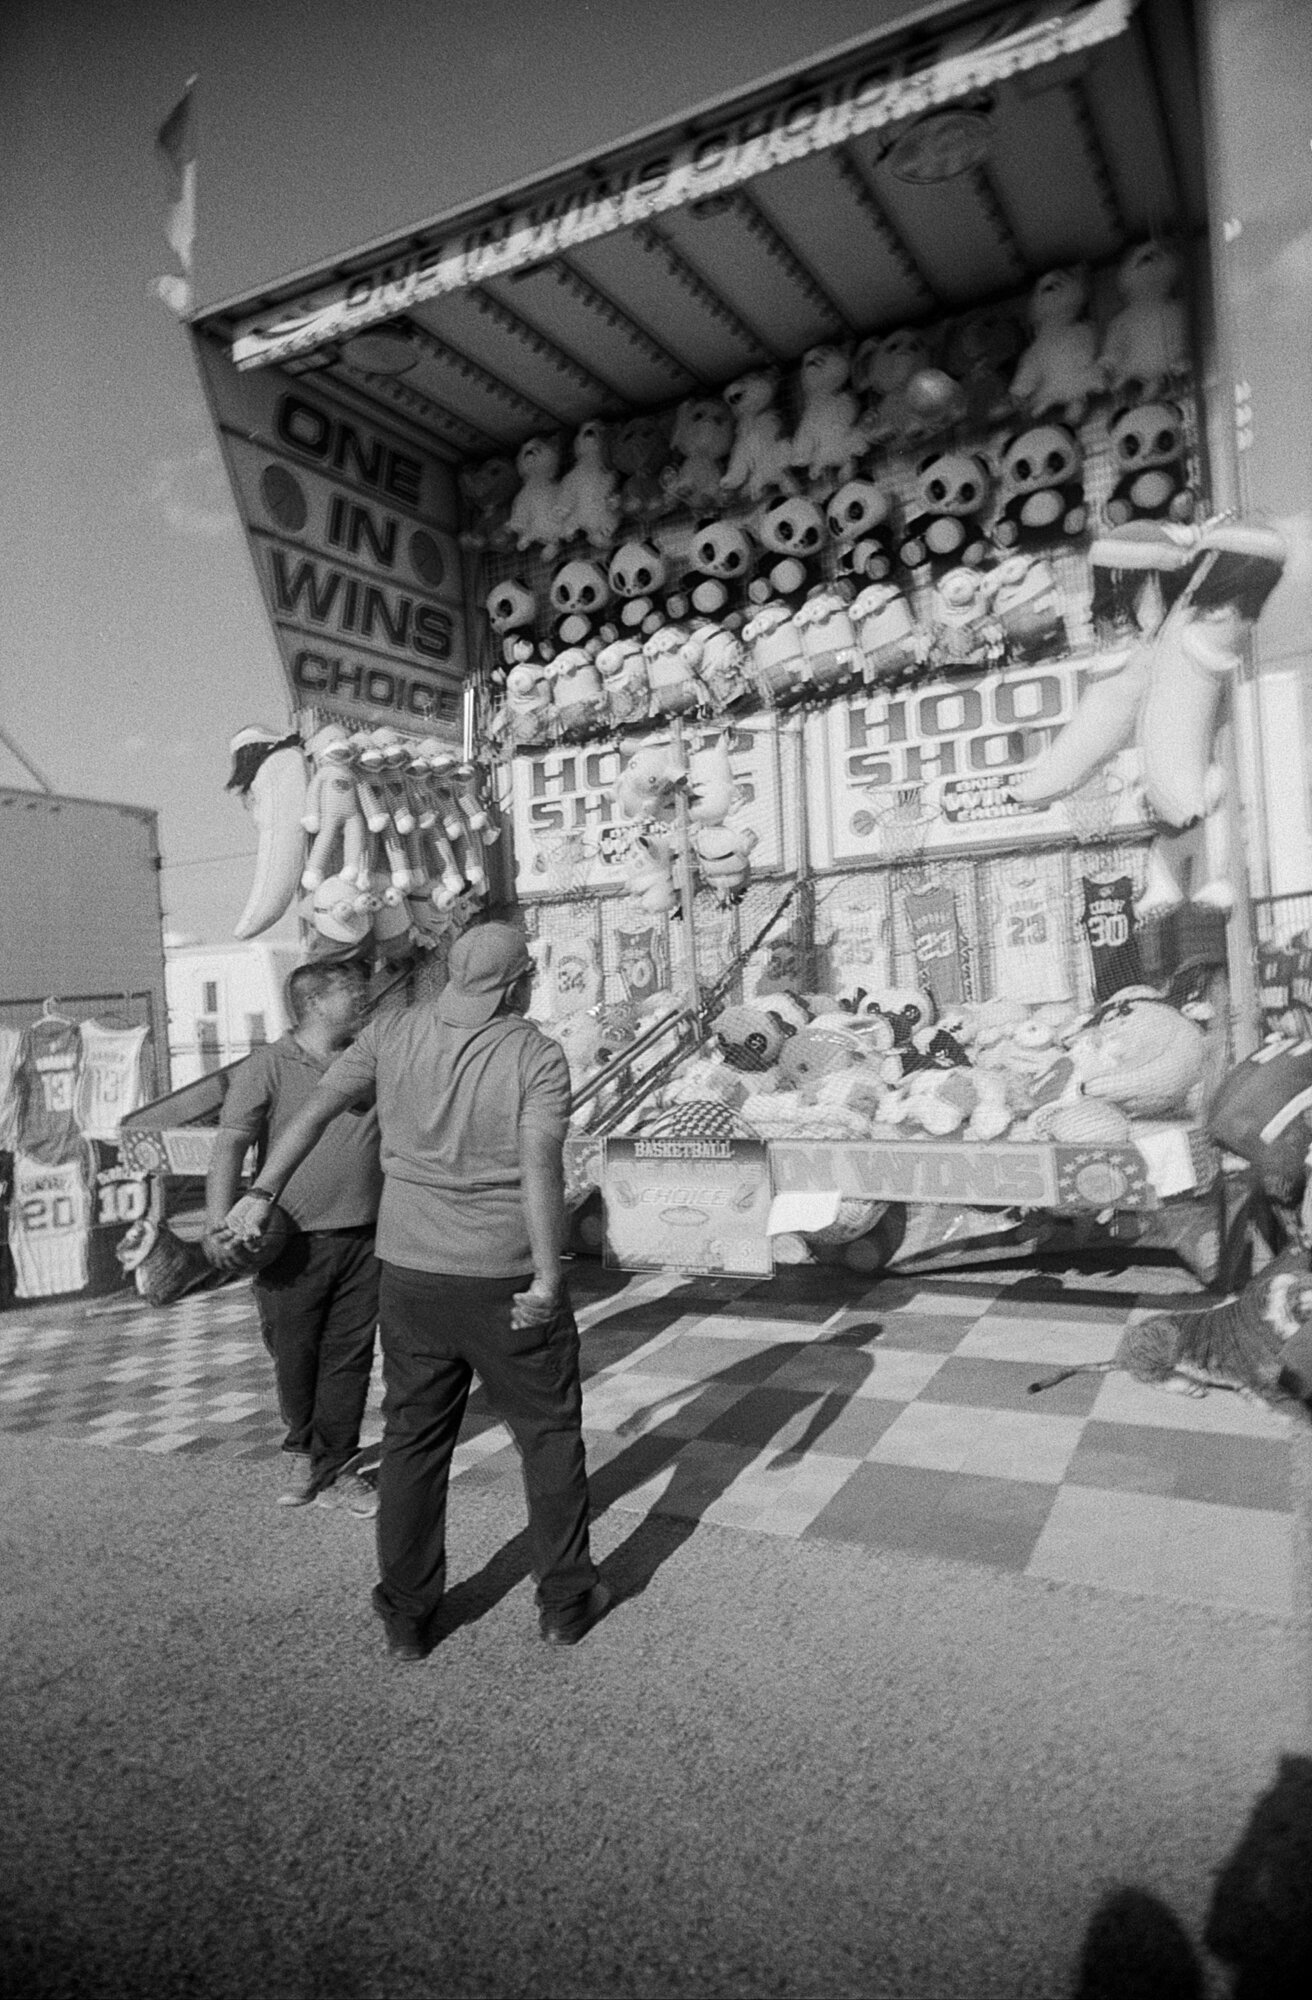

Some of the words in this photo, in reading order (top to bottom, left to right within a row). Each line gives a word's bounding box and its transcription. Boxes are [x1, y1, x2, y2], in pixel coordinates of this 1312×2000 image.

[346, 245, 442, 308] ONE
[460, 221, 514, 272] IN
[528, 153, 672, 247] WINS
[693, 42, 942, 174] CHOICE
[278, 395, 423, 507] ONE
[326, 495, 398, 569] IN
[270, 549, 453, 661] WINS
[293, 649, 461, 726] CHOICE
[916, 930, 955, 962] 23
[1007, 913, 1048, 948] 23
[1087, 913, 1129, 947] 30
[558, 970, 586, 995] 34
[41, 1071, 75, 1112] 13
[633, 1141, 733, 1160] BASKETBALL
[637, 1186, 735, 1207] CHOICE
[842, 1150, 1047, 1204] WINS
[22, 1197, 75, 1232] 20
[98, 1183, 147, 1225] 10
